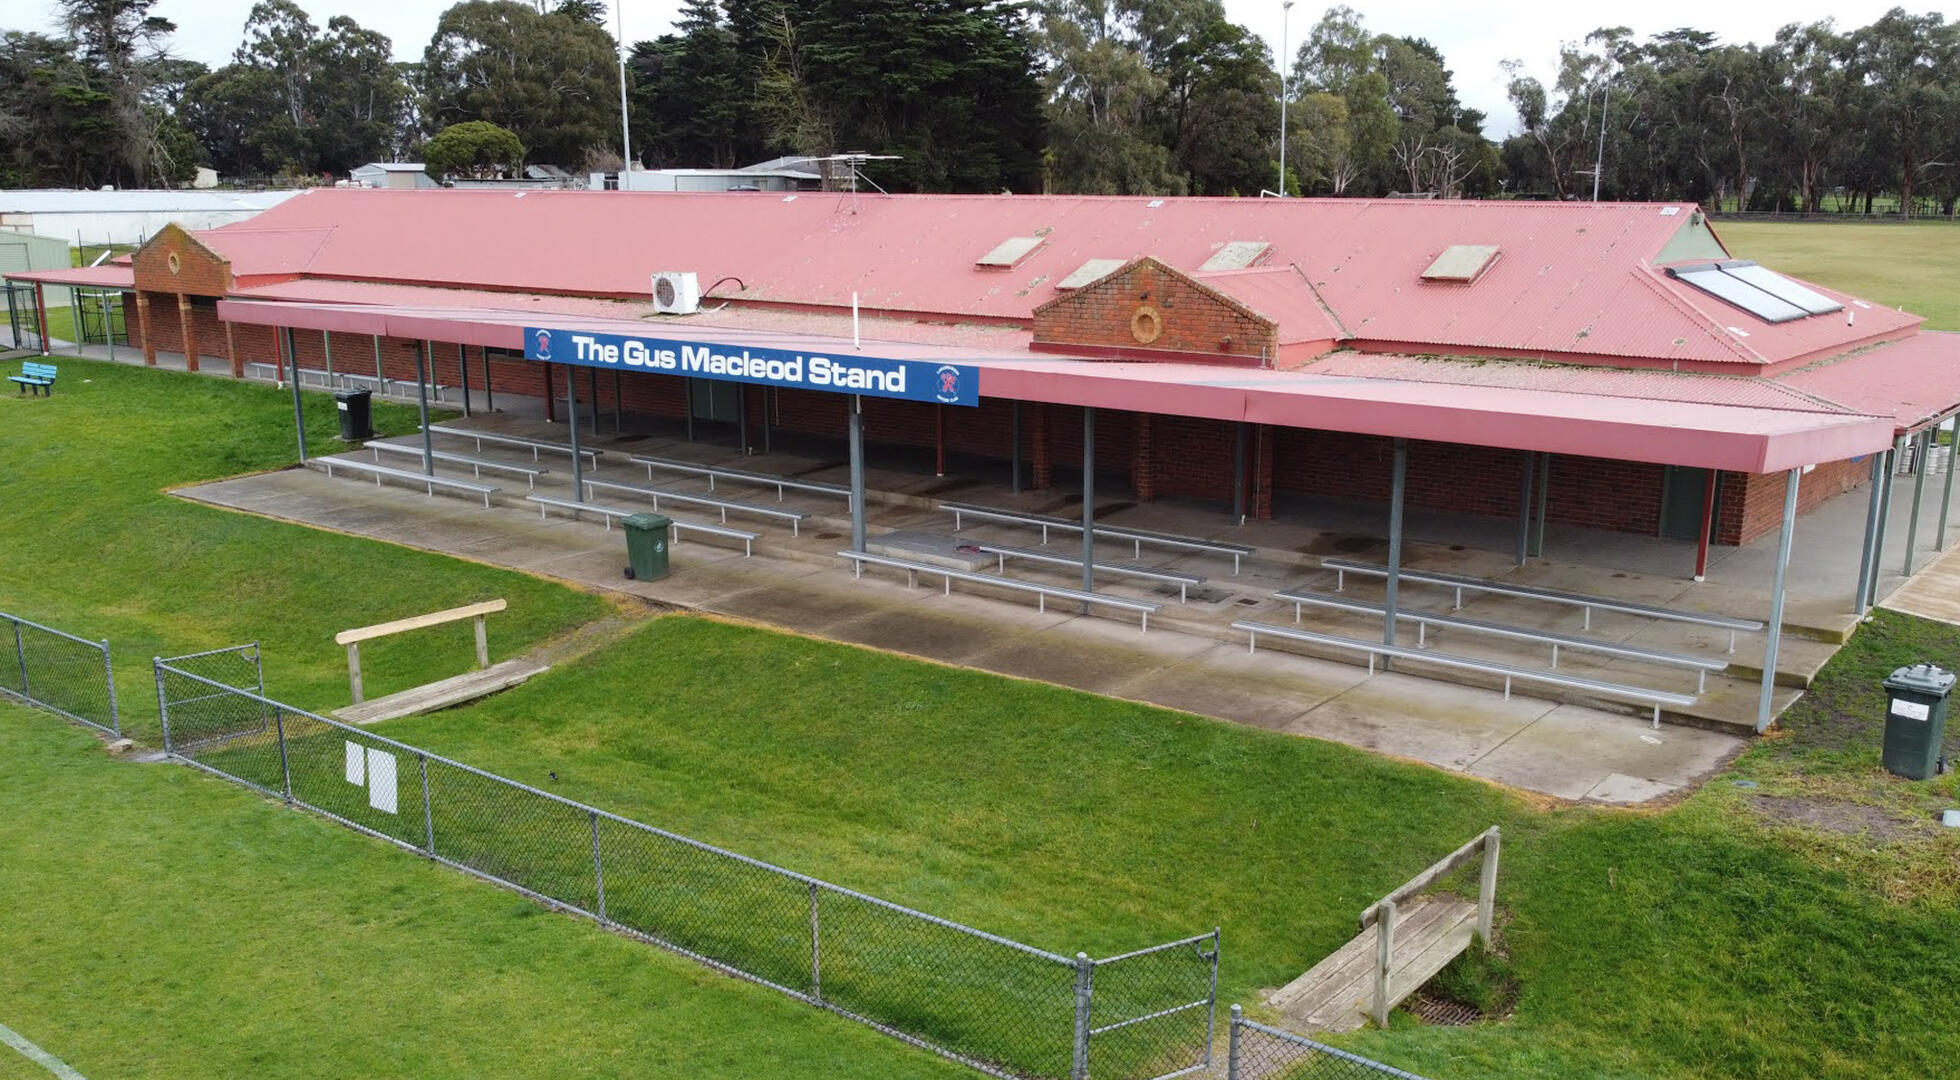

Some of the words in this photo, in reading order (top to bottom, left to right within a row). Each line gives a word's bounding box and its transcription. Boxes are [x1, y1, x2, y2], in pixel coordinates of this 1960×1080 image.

[572, 336, 618, 363] The
[623, 340, 676, 369] Gus
[681, 345, 802, 382] Macleod
[808, 357, 906, 392] Stand
